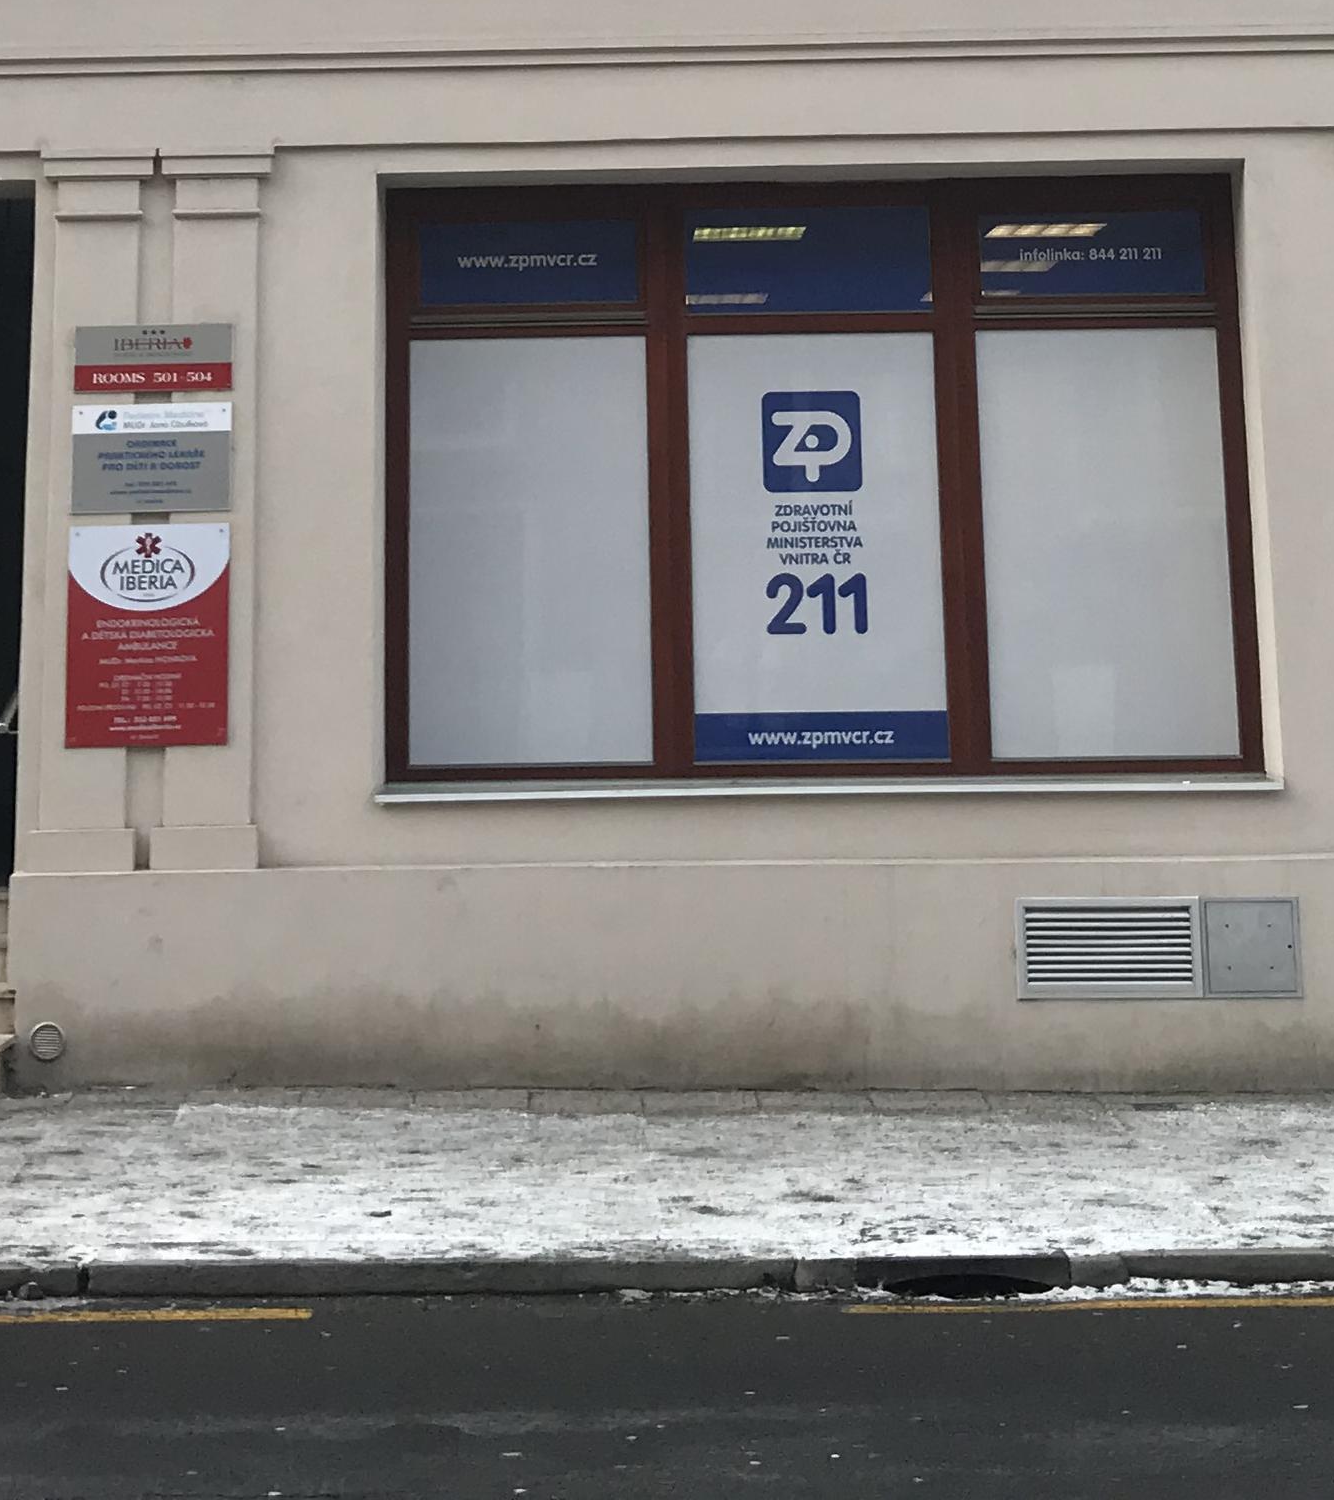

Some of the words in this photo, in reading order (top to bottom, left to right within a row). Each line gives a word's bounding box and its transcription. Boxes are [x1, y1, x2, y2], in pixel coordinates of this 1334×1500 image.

[457, 253, 598, 271] www.zpmvcr.cz
[1018, 248, 1085, 261] infolinka:
[1088, 248, 1116, 260] 844
[1119, 248, 1139, 260] 211
[1142, 247, 1163, 260] 211
[92, 372, 146, 384] ROOMS
[774, 500, 853, 517] ZDRAVOTNÍ
[771, 516, 858, 533] POJIŠŤOVNA
[766, 536, 864, 549] MINISTERSTVA
[779, 552, 829, 565] VNITRA
[832, 548, 852, 565] ČR
[112, 558, 186, 575] MEDICA
[119, 575, 178, 591] IBERIA
[765, 572, 869, 635] 211
[747, 730, 895, 749] www.zpmvcr.cz
